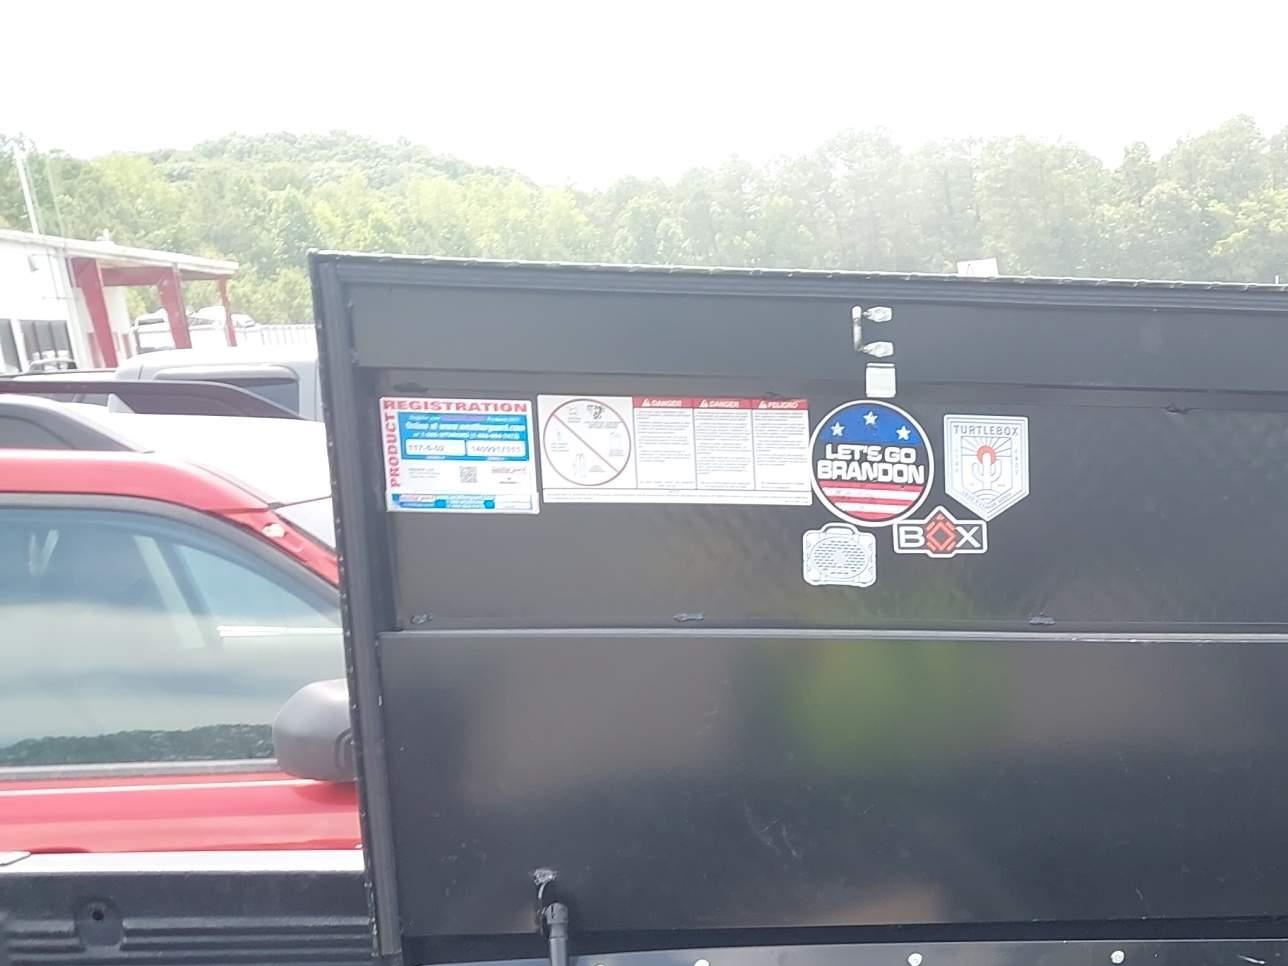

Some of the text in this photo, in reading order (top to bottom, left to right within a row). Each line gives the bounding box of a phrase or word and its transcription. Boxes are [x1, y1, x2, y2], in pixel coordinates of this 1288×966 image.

[383, 399, 528, 413] REGISTRATION
[650, 399, 683, 408] DANGER
[708, 400, 740, 409] DANGER
[767, 401, 799, 410] PELIGRO
[952, 424, 1020, 437] TURTLEBOX
[384, 413, 401, 488] PRODUCT
[825, 443, 917, 464] LET'S GO
[817, 459, 925, 485] BRANDON
